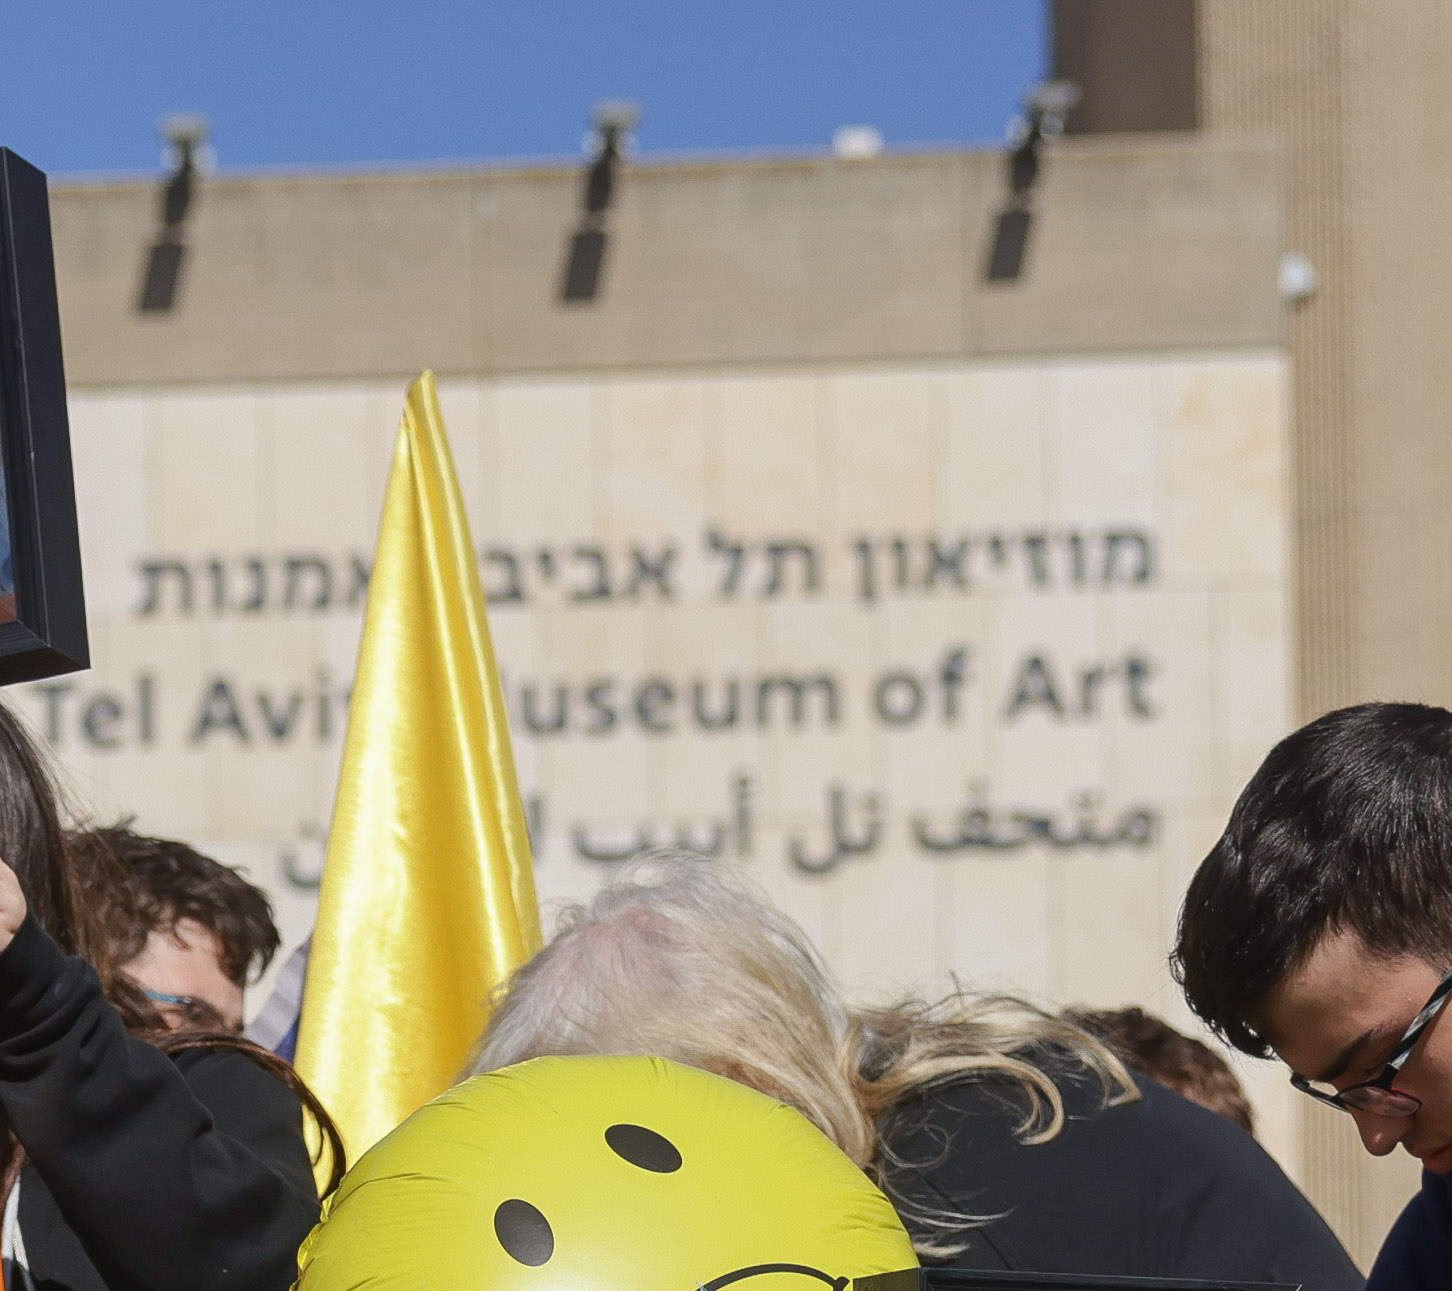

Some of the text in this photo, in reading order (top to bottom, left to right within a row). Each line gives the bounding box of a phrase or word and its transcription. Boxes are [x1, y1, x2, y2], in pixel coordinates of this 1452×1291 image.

[706, 527, 820, 599] תל
[853, 529, 1157, 606] מוזיאון
[37, 642, 1156, 747] Tel Avi useum of Art
